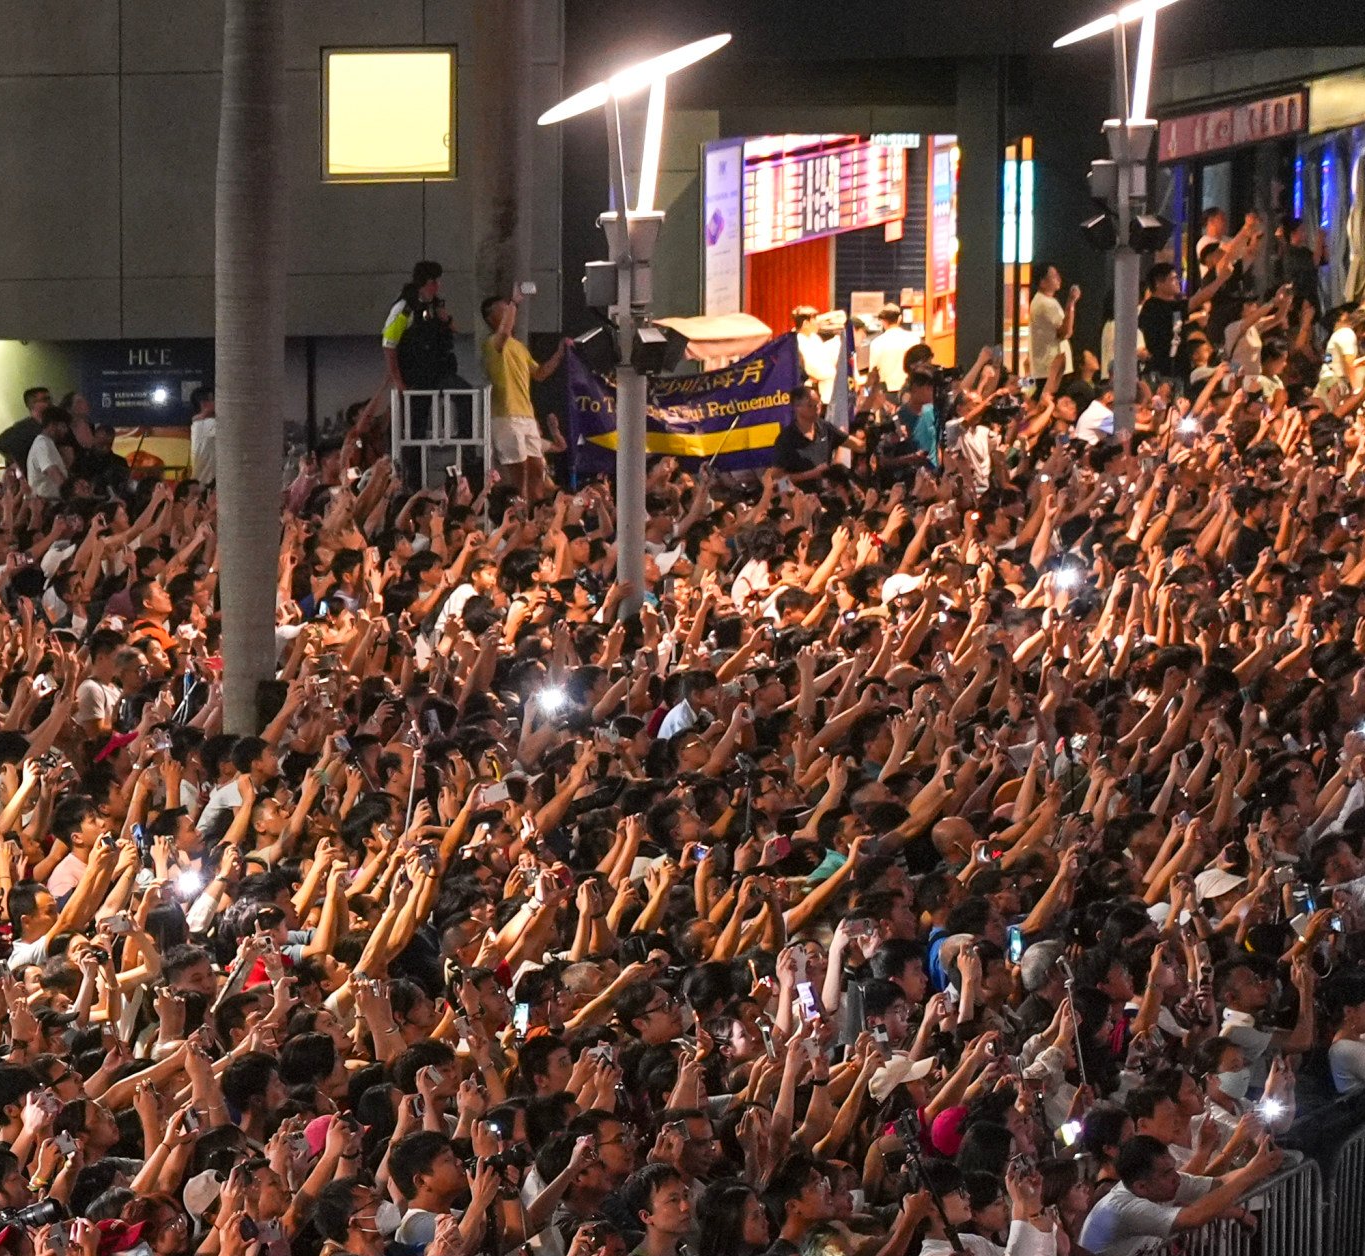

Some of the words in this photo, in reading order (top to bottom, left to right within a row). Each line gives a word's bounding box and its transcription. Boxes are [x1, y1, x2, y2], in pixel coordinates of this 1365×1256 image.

[128, 348, 172, 366] HUE
[577, 395, 601, 412] To
[707, 389, 791, 418] Promenade
